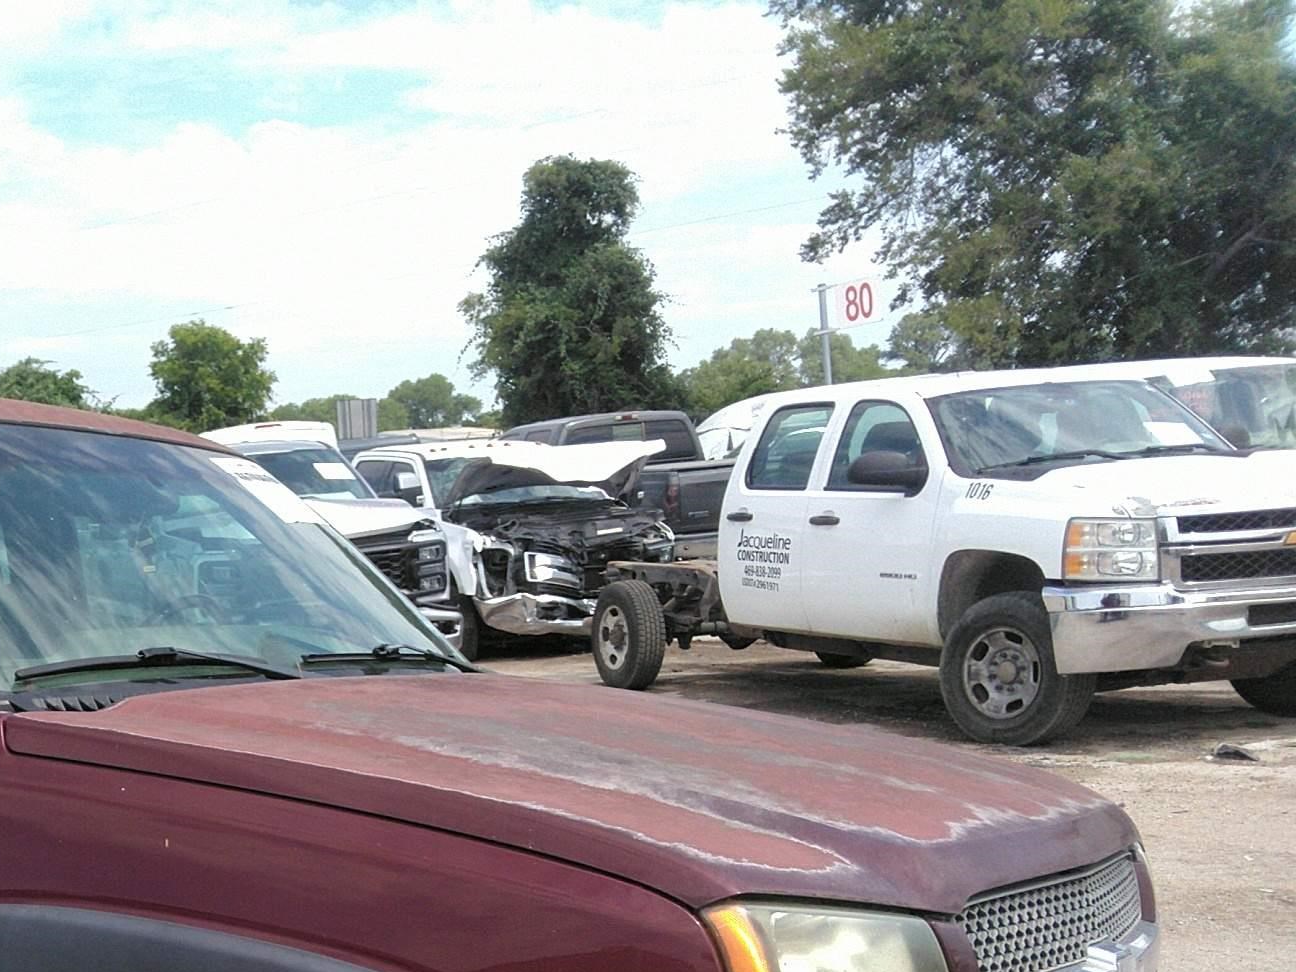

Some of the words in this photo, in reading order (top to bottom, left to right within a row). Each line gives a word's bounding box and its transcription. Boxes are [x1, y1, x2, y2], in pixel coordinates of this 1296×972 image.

[846, 282, 872, 321] 80
[965, 482, 994, 500] 1016
[737, 528, 791, 550] Jacqueline
[737, 550, 790, 564] CONSTRUCTION
